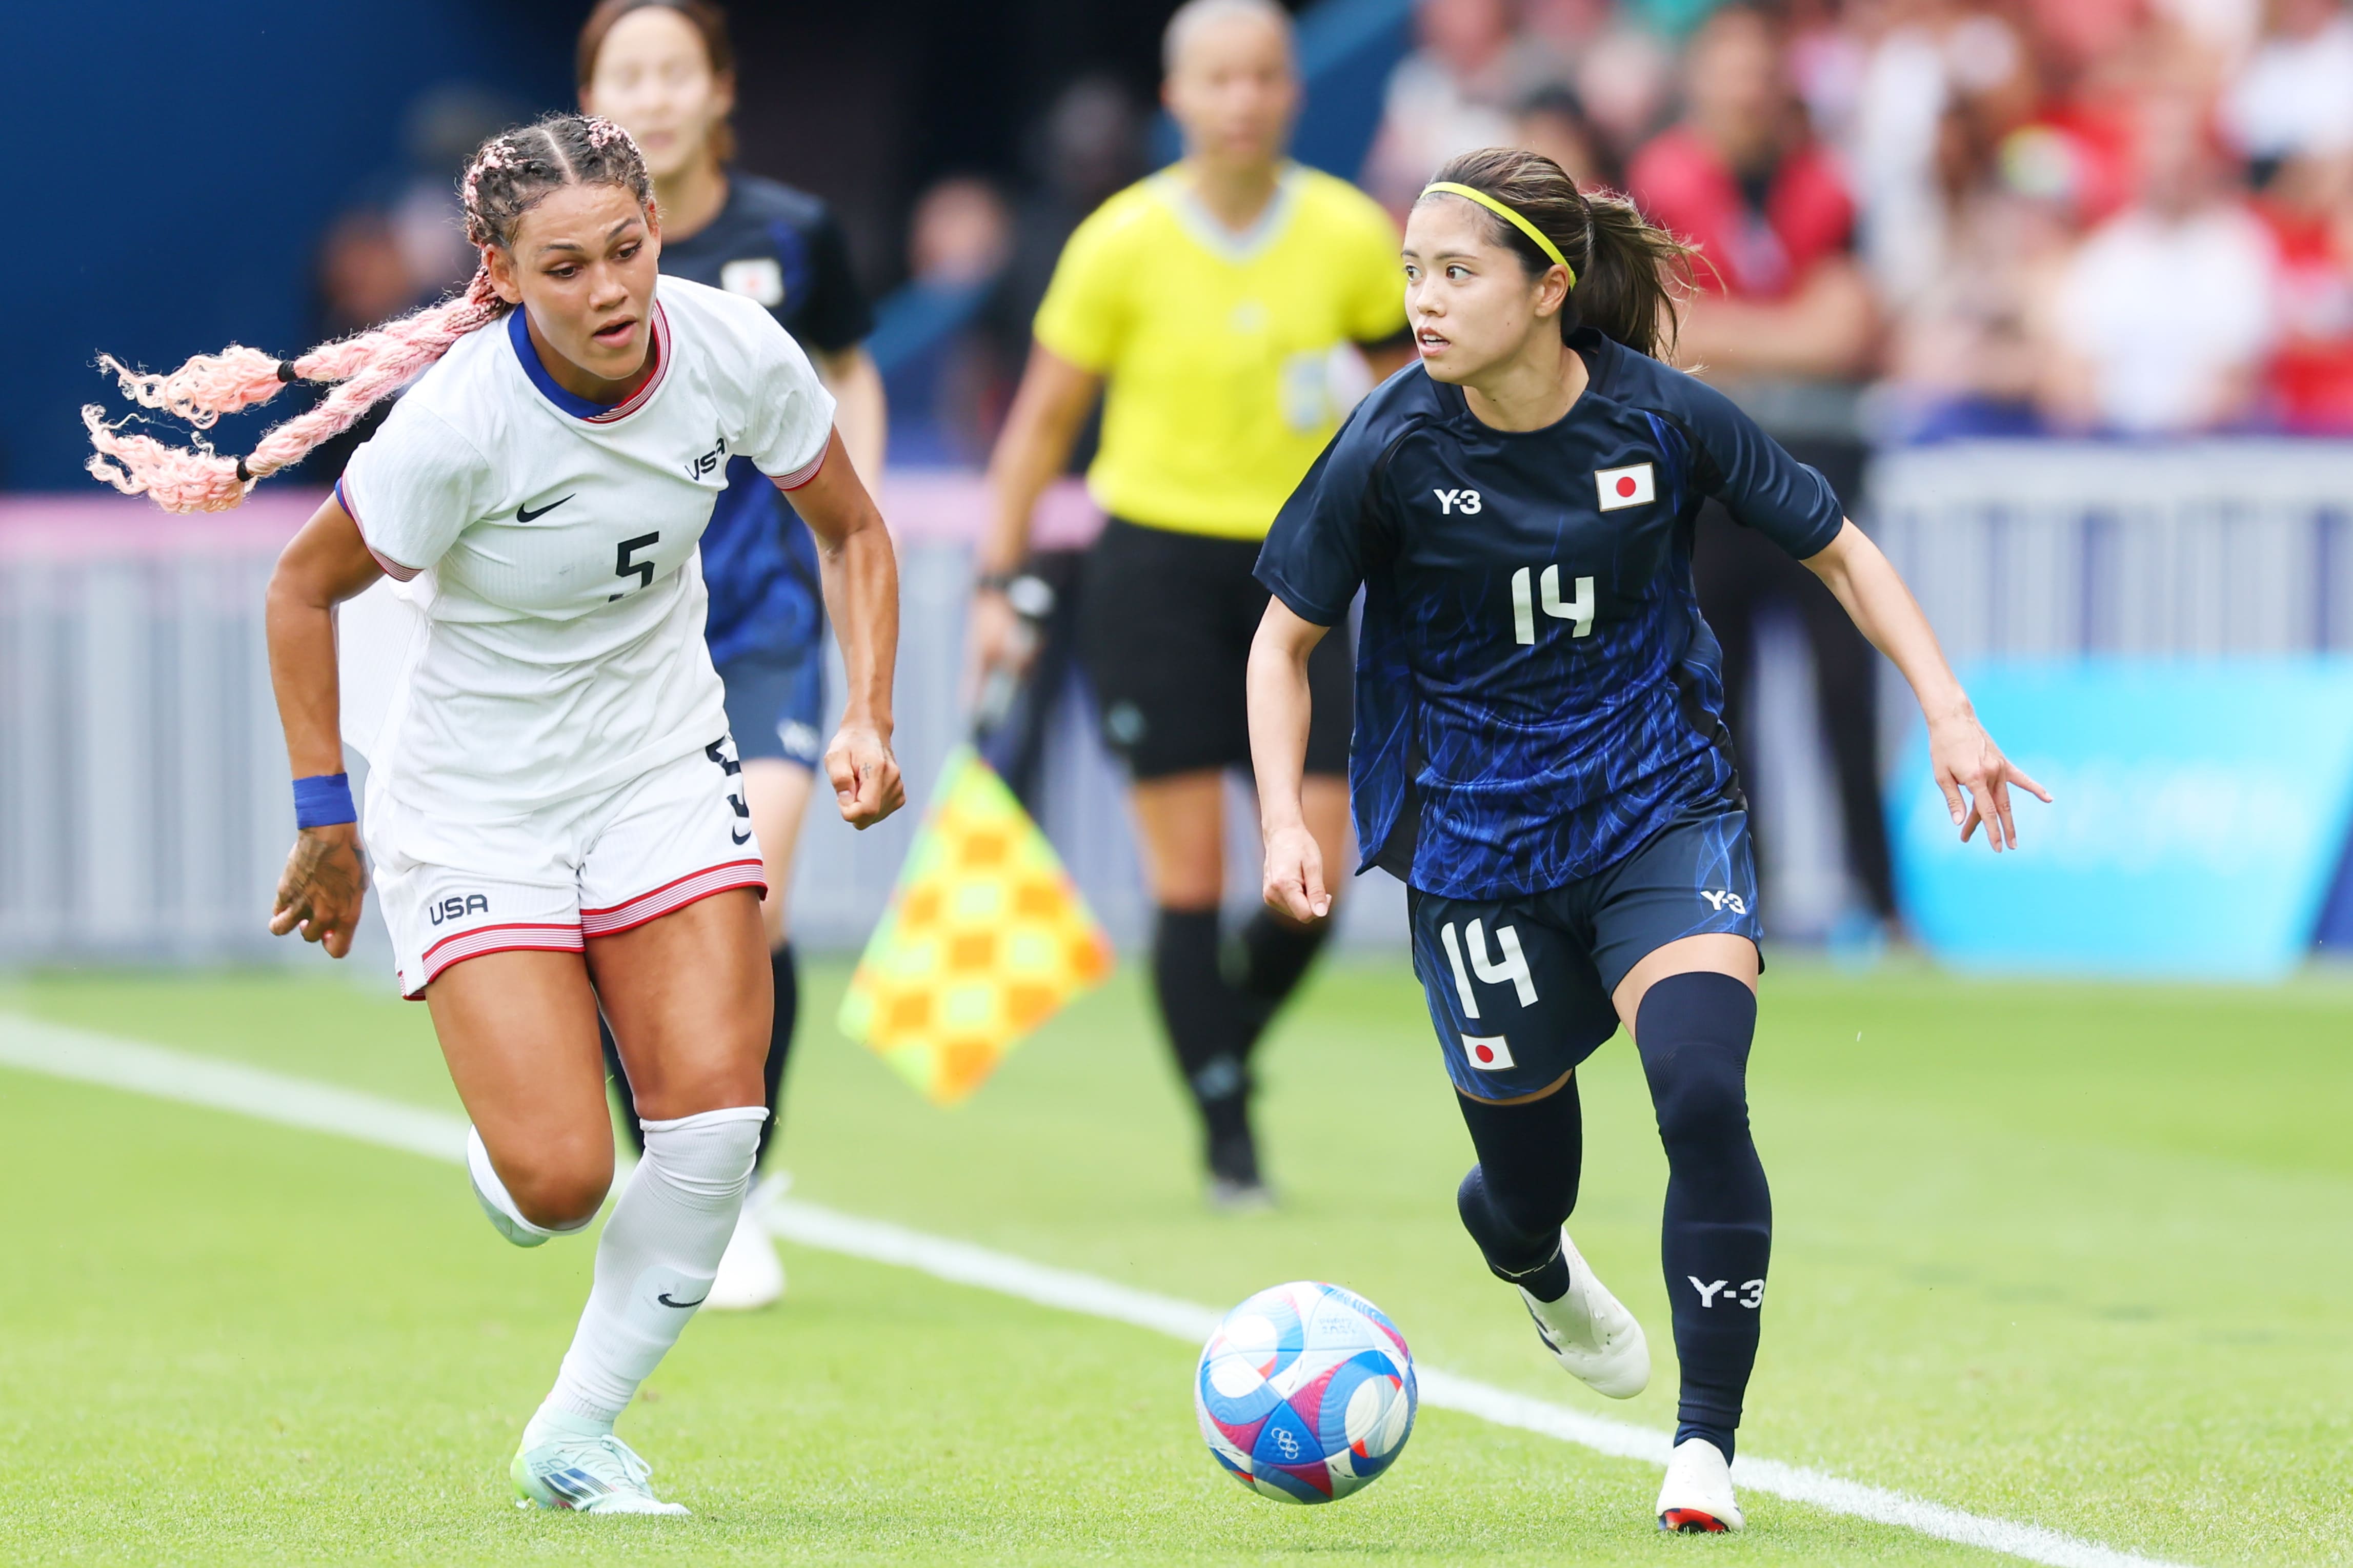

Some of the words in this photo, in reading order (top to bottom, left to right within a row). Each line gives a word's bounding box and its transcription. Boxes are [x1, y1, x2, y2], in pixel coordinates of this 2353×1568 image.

[685, 437, 725, 481] USA
[1433, 489, 1482, 515] Y-3
[608, 531, 659, 603] 5
[1512, 564, 1595, 645] 14
[430, 894, 489, 926] USA
[1700, 890, 1746, 914] Y-3
[1441, 918, 1539, 1020] 14
[1687, 1275, 1765, 1309] Y-3
